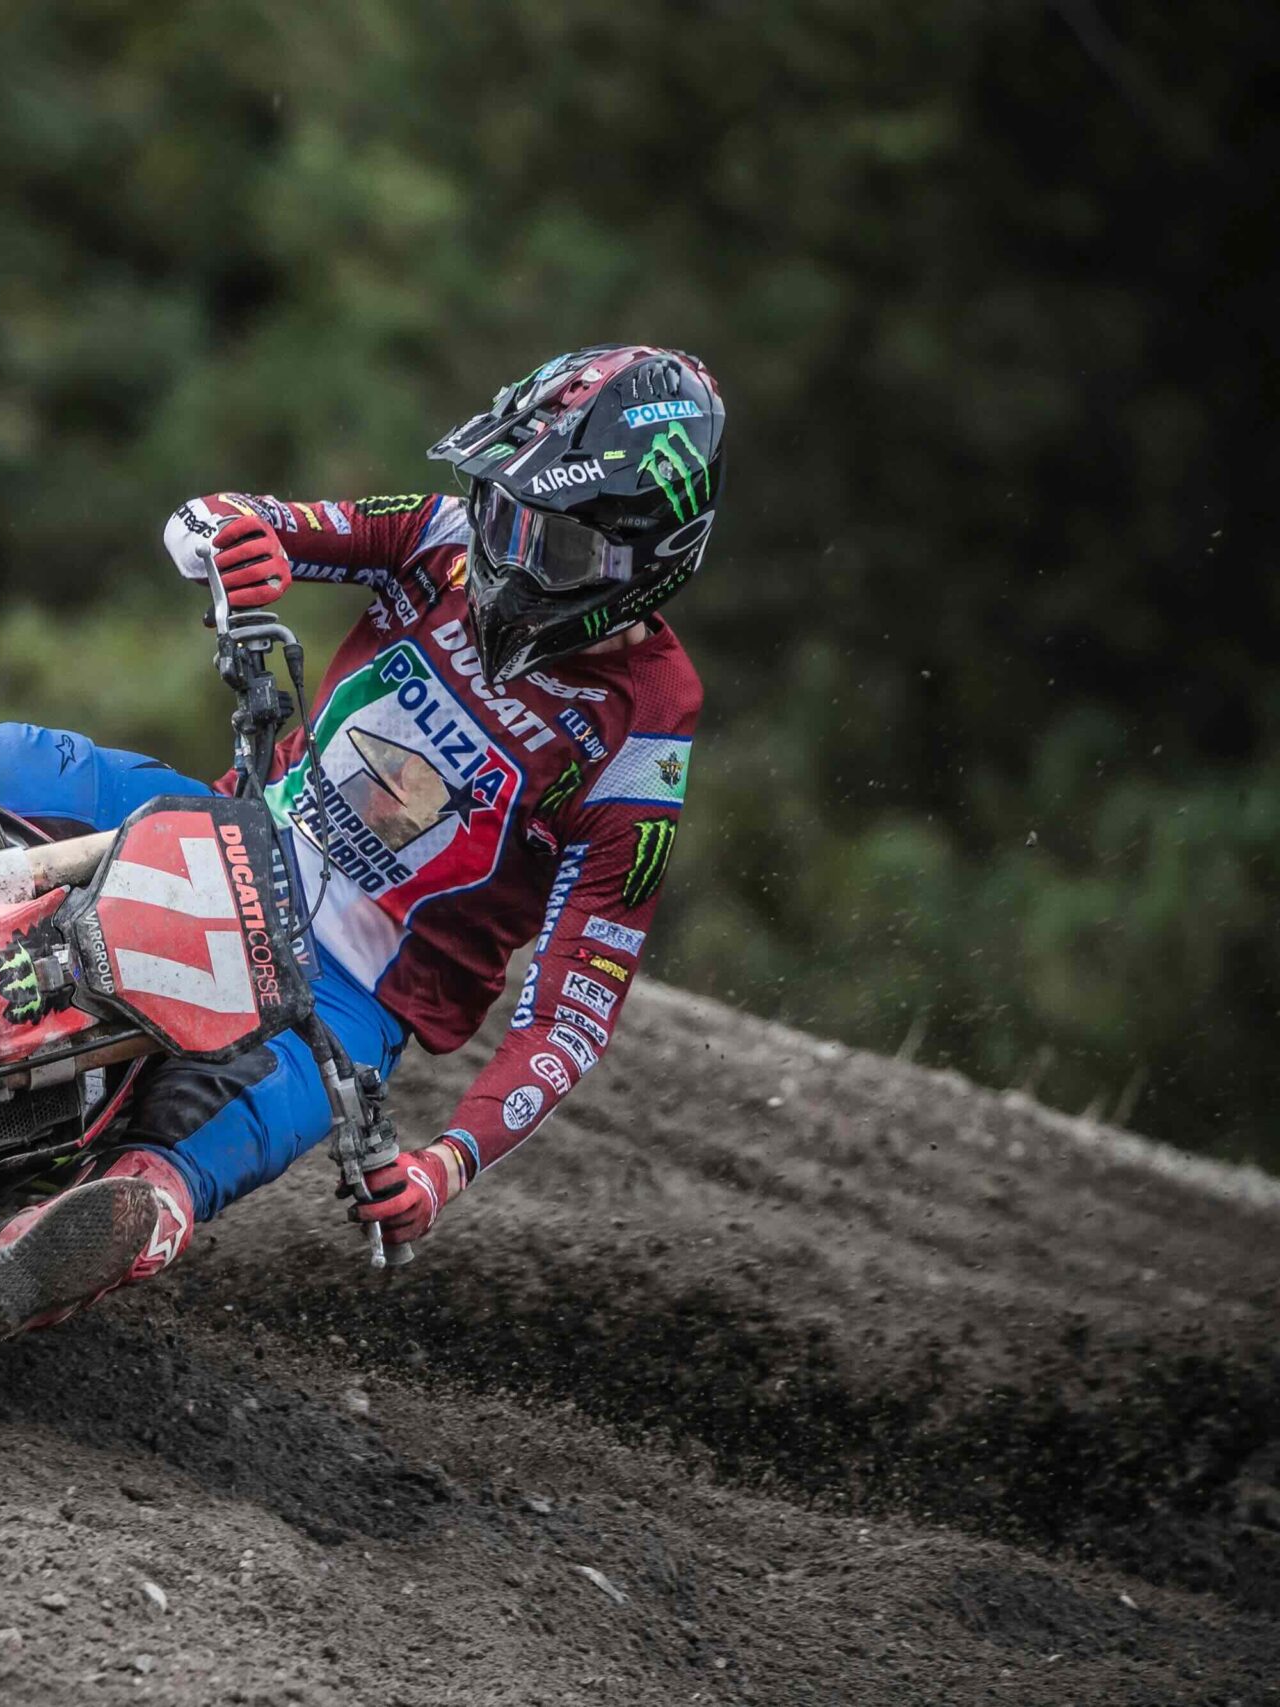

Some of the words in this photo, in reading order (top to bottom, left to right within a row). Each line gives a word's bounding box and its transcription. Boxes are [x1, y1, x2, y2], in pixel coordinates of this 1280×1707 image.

[624, 401, 701, 426] POLIZIA
[532, 459, 606, 494] AIROH
[618, 517, 648, 527] AIROH
[500, 649, 525, 681] AIROH
[380, 650, 508, 808] POLIZIA
[100, 837, 256, 1013] 77
[84, 911, 115, 994] VARGROUP
[569, 974, 614, 1007] KEY
[556, 1030, 593, 1065] GET
[508, 1093, 535, 1125] STM
